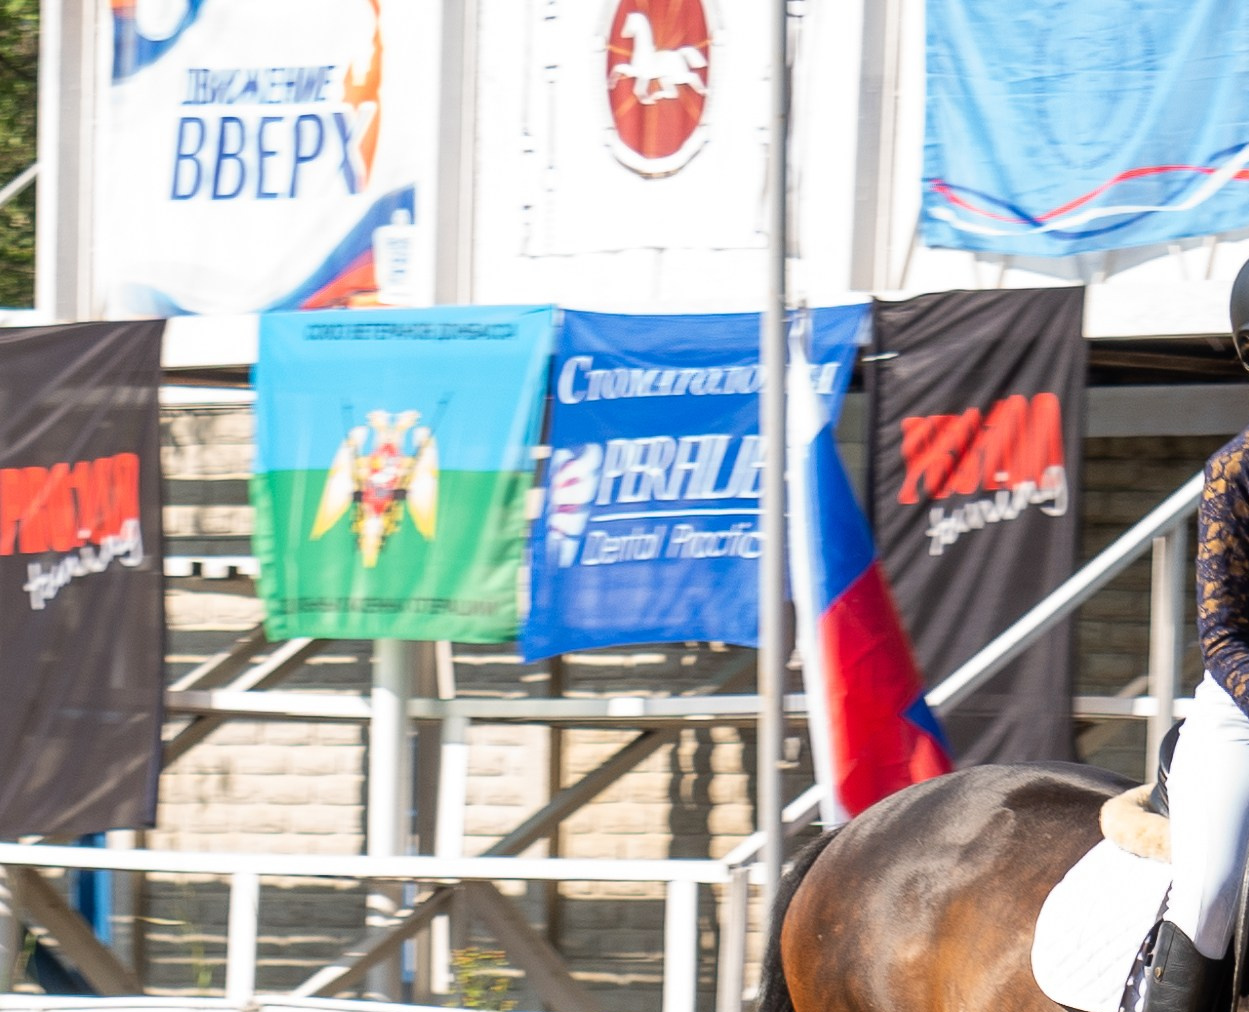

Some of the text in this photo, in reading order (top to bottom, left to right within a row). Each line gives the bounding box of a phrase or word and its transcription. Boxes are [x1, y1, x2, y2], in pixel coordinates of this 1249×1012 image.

[181, 65, 336, 105] ДВИЖЕНИЕ
[170, 104, 376, 200] ВВЕРХ
[579, 522, 767, 566] Dental Practic
